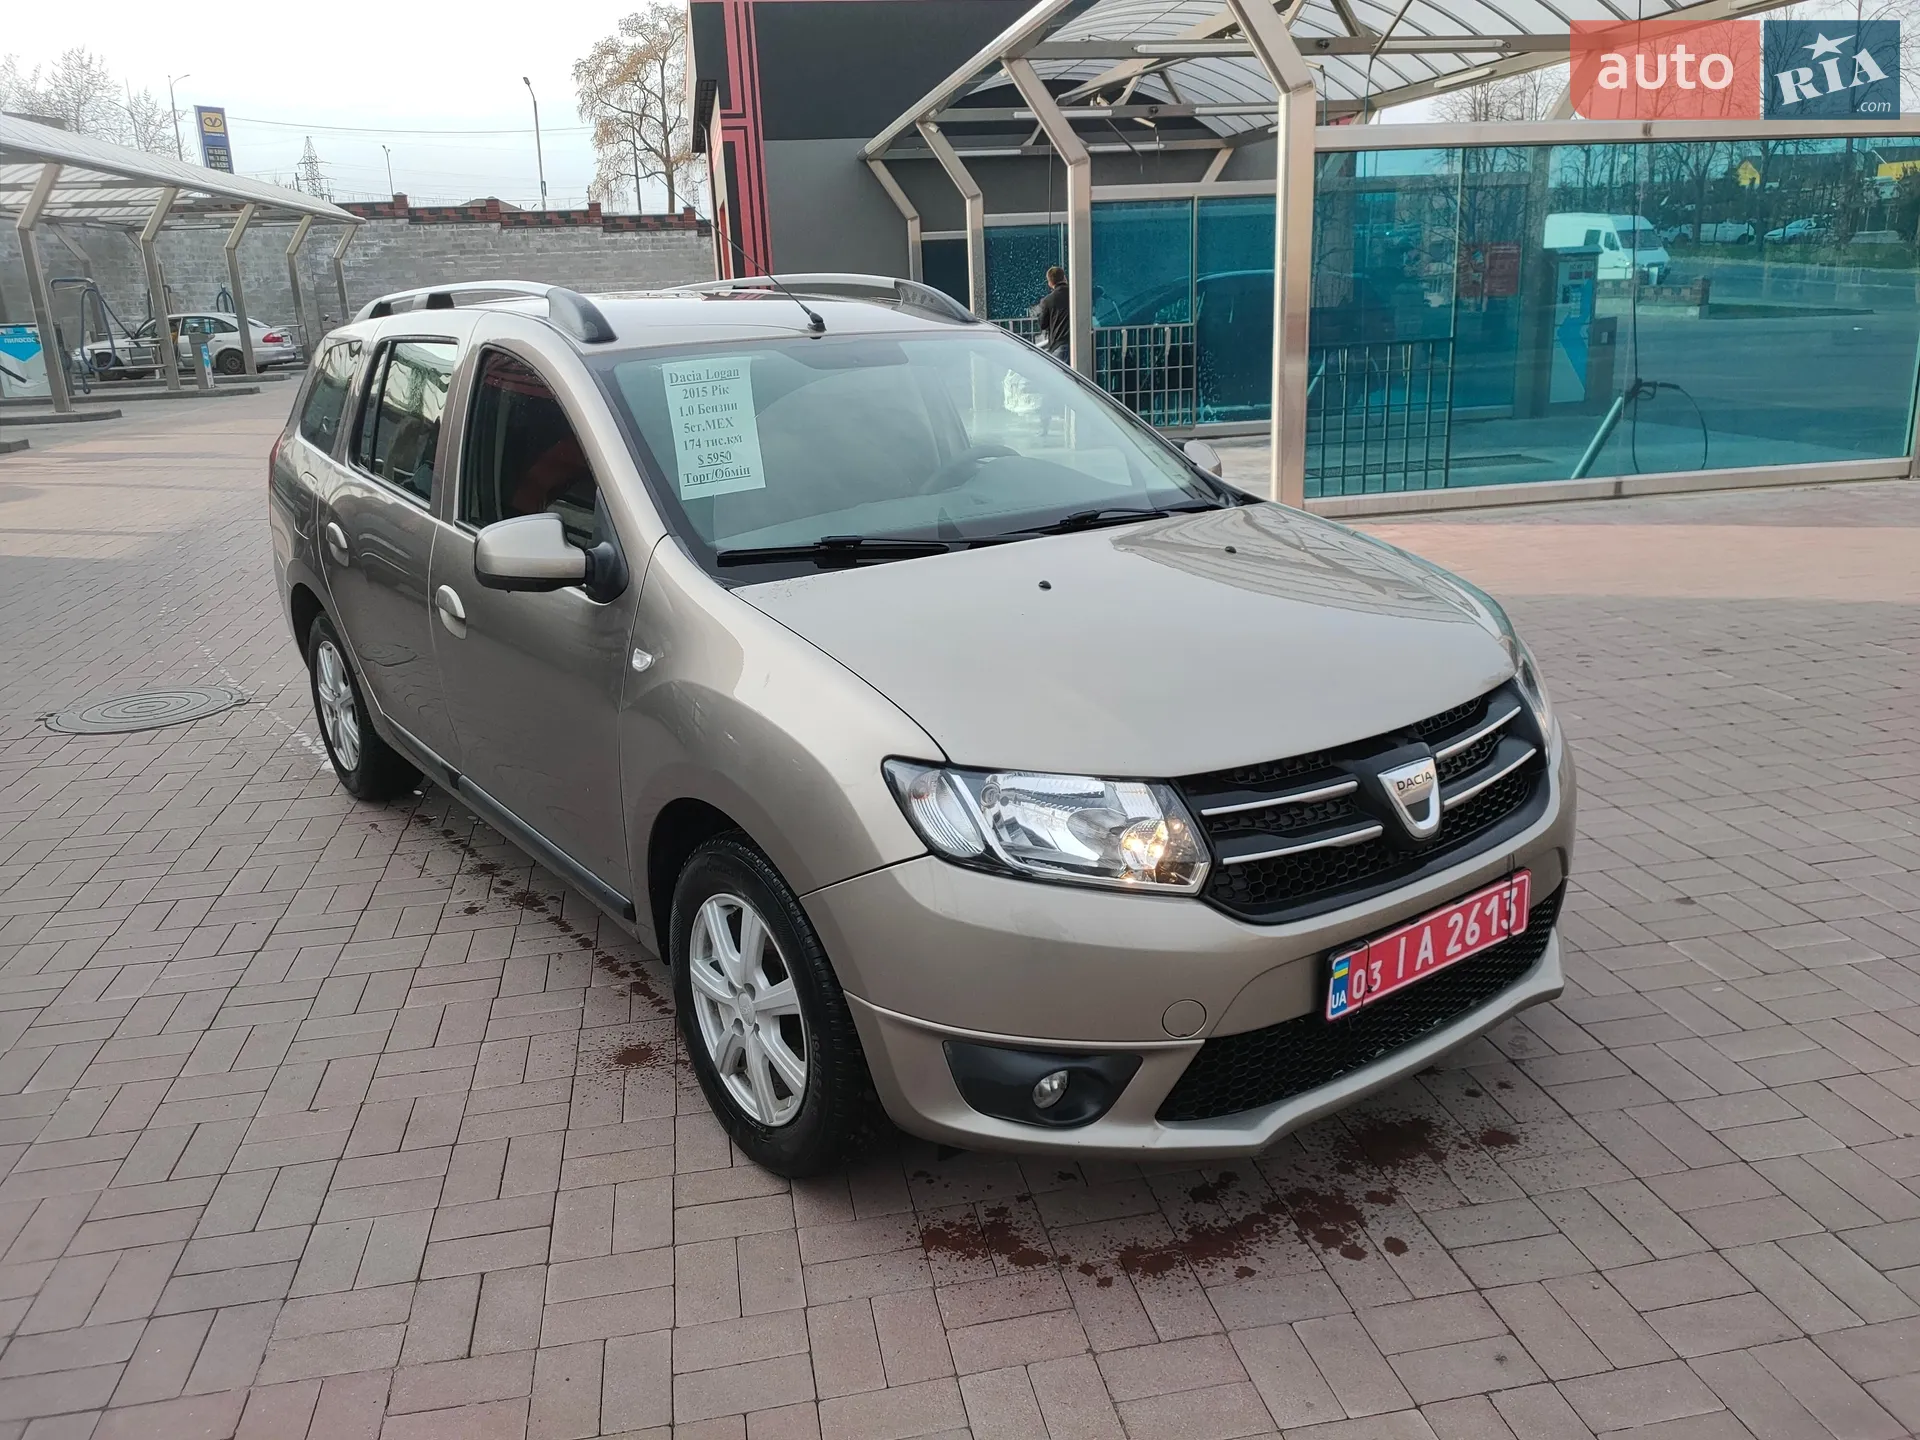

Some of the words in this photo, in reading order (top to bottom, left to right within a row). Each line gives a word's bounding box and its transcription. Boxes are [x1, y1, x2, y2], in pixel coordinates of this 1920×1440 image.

[669, 370, 702, 384] Dacia
[706, 368, 740, 382] Logan
[682, 386, 708, 400] 2015
[711, 384, 729, 396] Рік
[679, 405, 695, 417] 1.0
[697, 402, 738, 415] Бензин
[683, 438, 701, 450] 174
[707, 451, 732, 465] 5950
[1396, 771, 1433, 791] DACIA
[1352, 960, 1383, 999] 03
[1446, 887, 1518, 957] 2613
[1332, 992, 1347, 1009] UA
